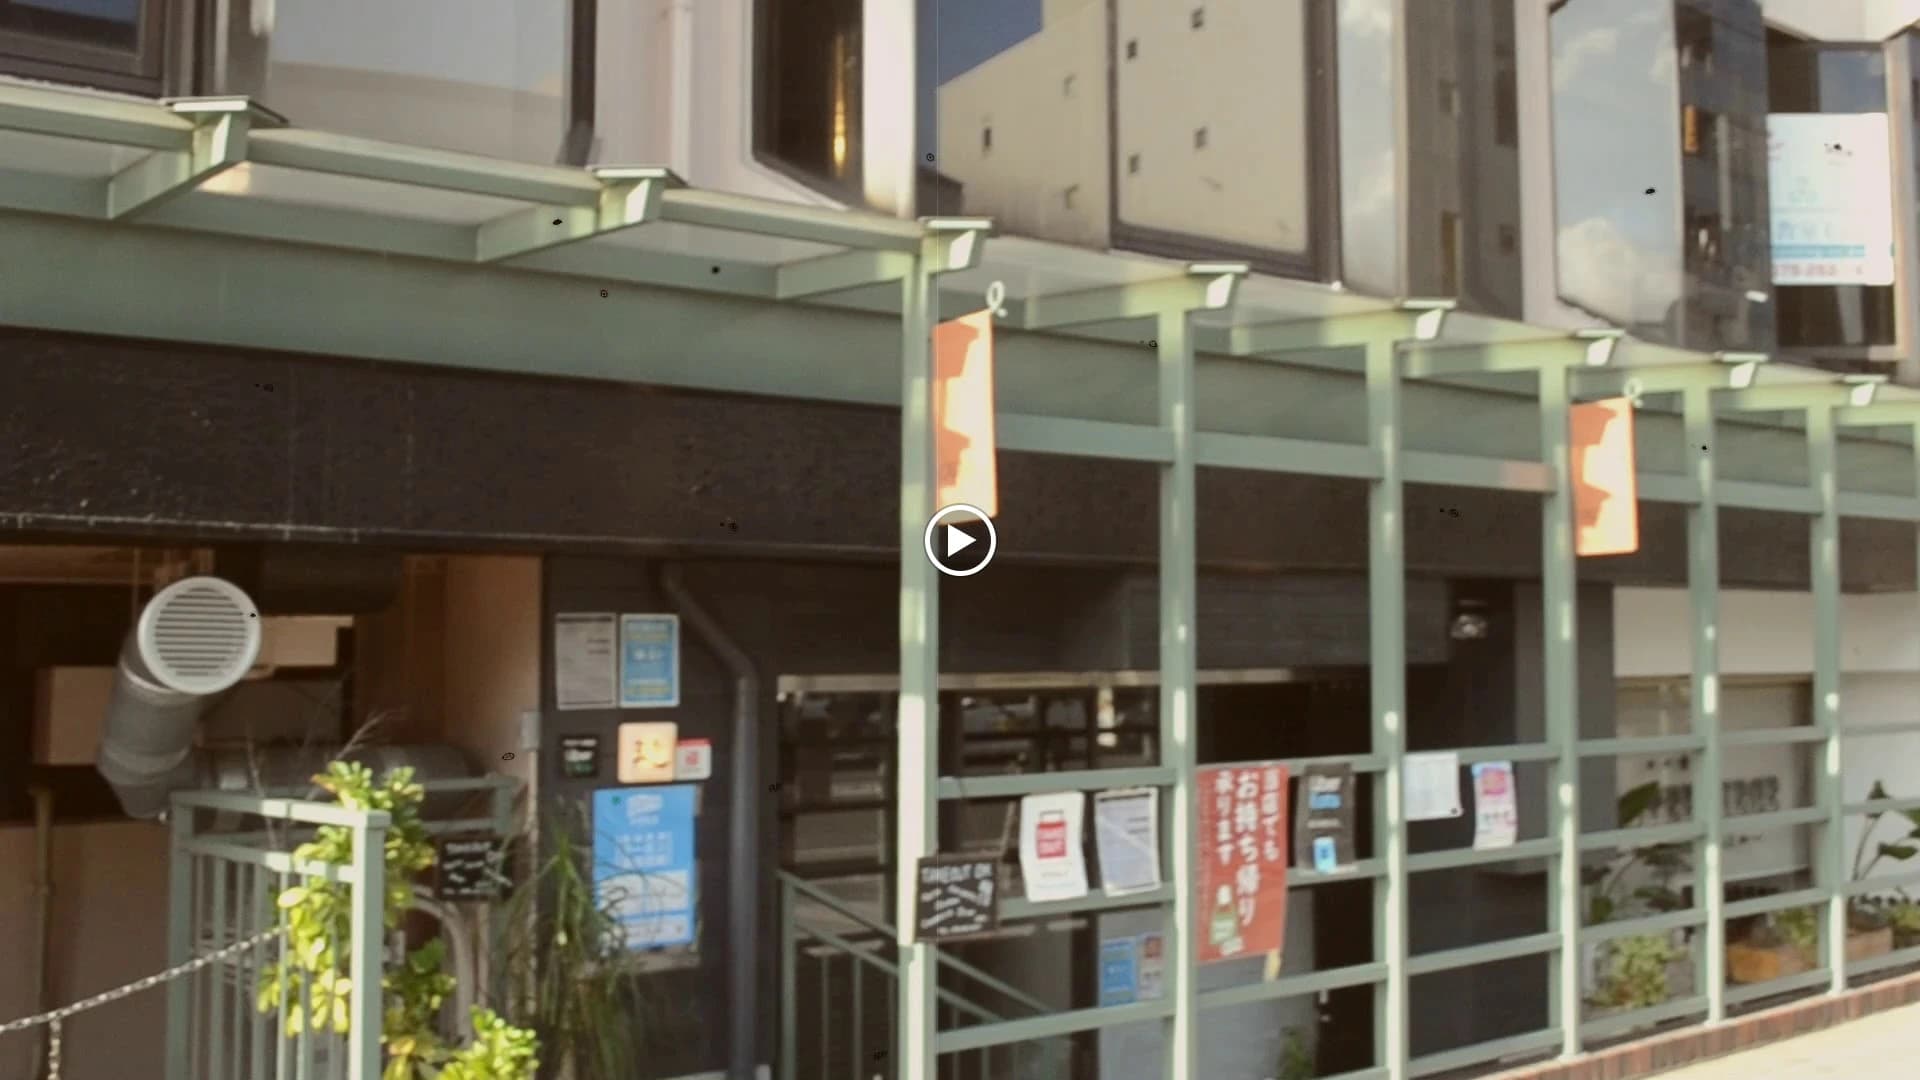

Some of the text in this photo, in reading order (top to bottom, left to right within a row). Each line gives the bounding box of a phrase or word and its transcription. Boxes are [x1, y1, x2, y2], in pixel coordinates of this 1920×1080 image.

[1233, 770, 1261, 927] お持ち帰り
